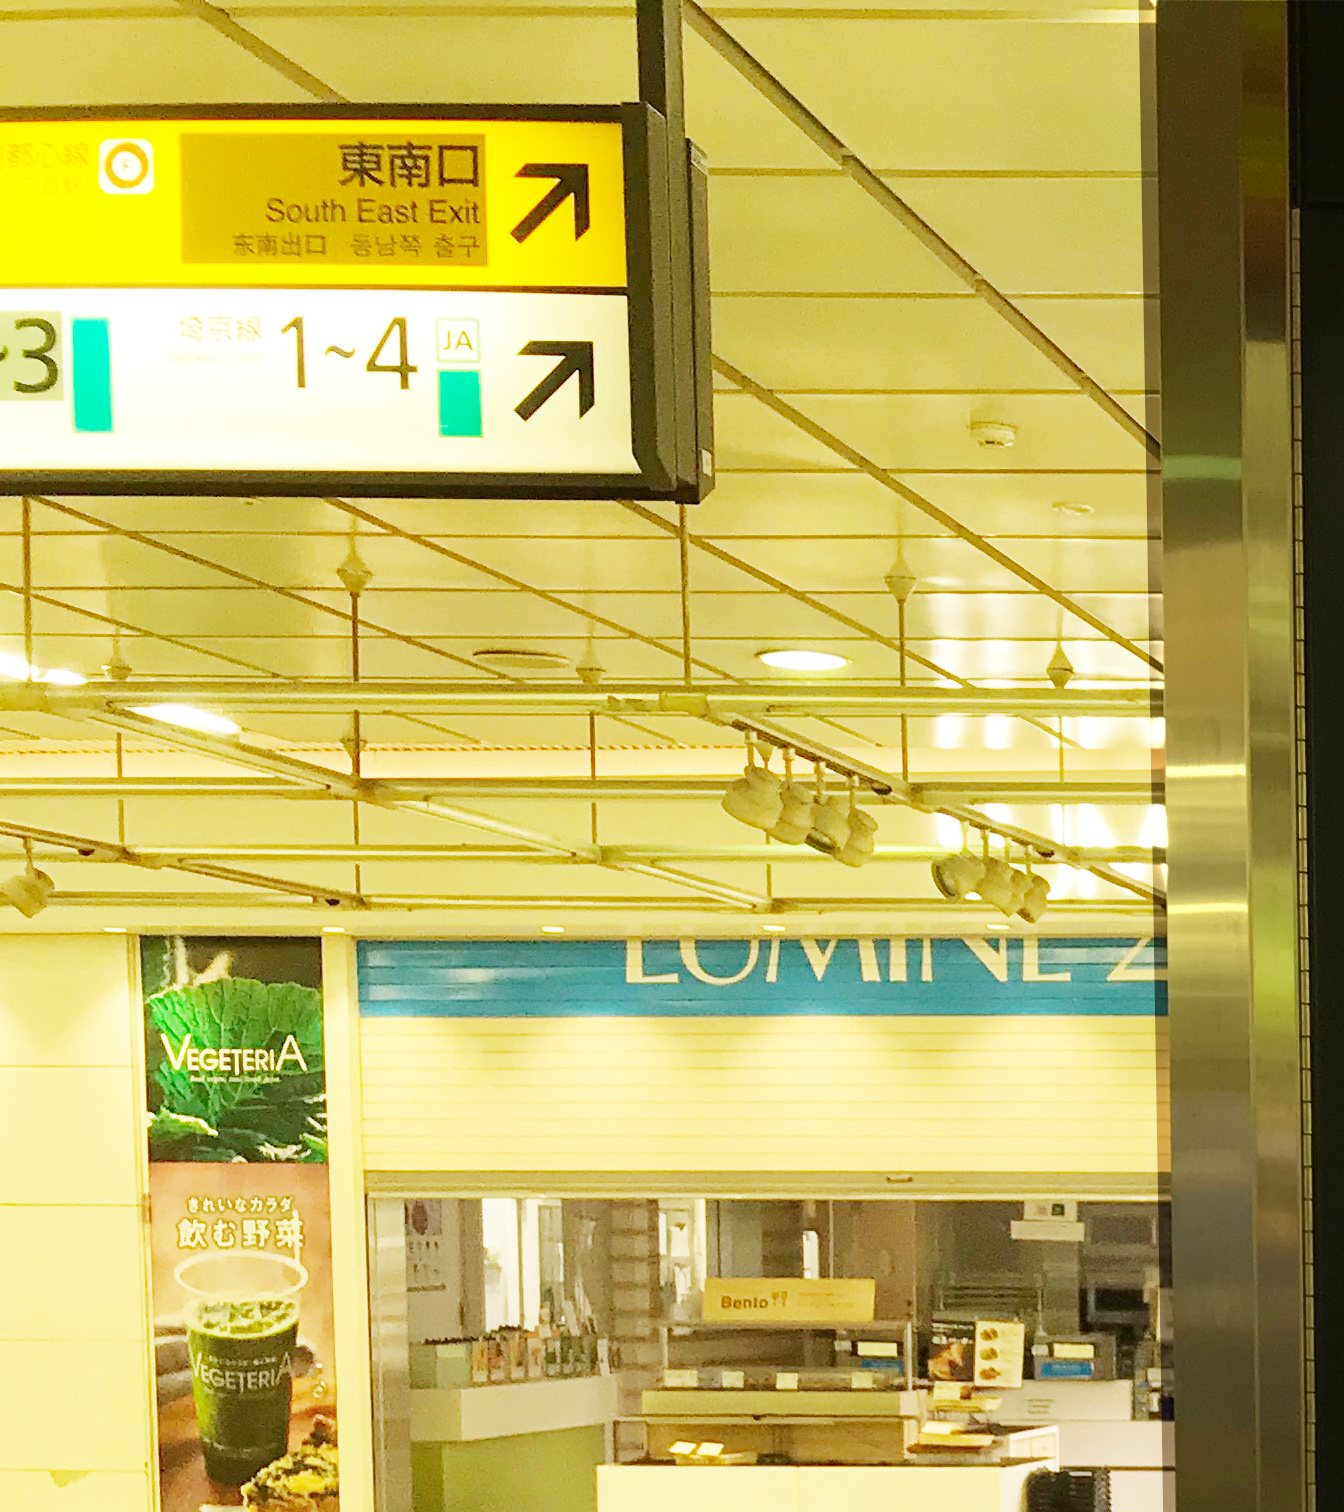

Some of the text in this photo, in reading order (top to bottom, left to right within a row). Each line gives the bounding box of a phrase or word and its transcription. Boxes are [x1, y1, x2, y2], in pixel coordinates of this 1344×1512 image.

[0, 141, 90, 169] 都心線
[338, 140, 480, 188] 東南口
[265, 197, 481, 224] South East Exit
[231, 233, 327, 257] 东南出口
[350, 233, 480, 258] 동남쪽 출구
[178, 315, 263, 342] 埼京線
[442, 329, 474, 353] JA
[160, 1033, 308, 1075] VEGETERIA
[187, 1196, 293, 1213] きれいなカラダ
[177, 1219, 304, 1248] 飲む野菜
[720, 1294, 769, 1311] Bento
